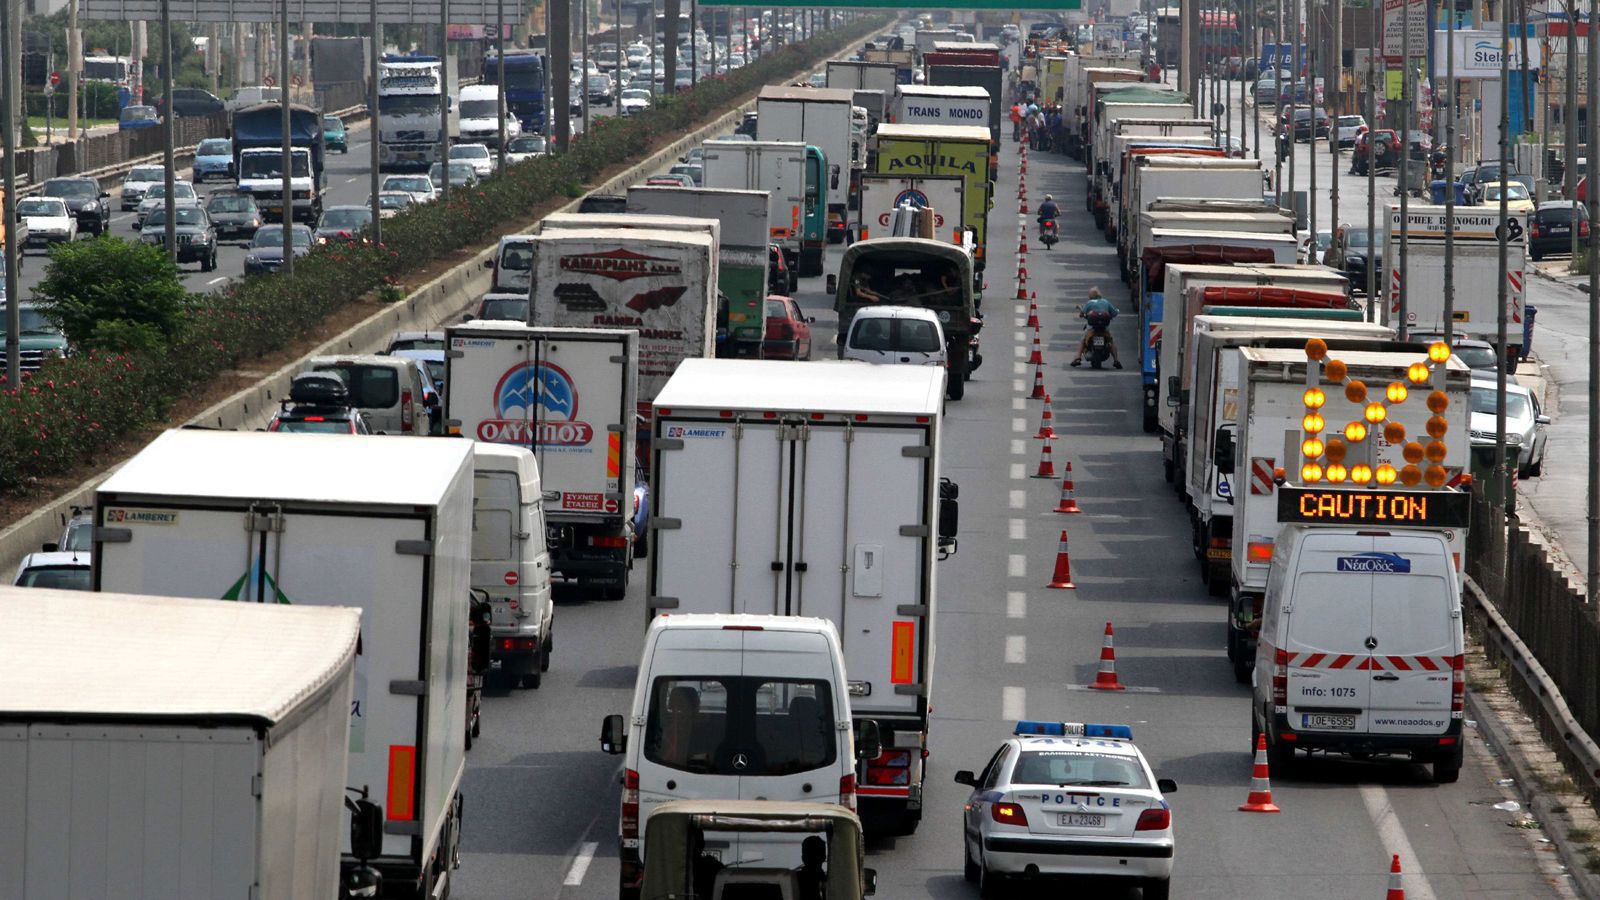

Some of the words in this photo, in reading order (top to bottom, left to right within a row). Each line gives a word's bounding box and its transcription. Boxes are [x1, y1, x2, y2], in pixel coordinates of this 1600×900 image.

[908, 106, 941, 118] TRANS
[949, 108, 983, 119] MONDO
[888, 154, 977, 174] AQUILA
[1393, 215, 1433, 225] OPHEE
[1439, 215, 1495, 226] BINOGLOU
[683, 429, 725, 437] LAMBERET
[566, 501, 599, 509] ΣΤΑΣΕΙΣ
[1300, 493, 1427, 520] CAUTION
[124, 512, 176, 521] LAMBERET
[1343, 558, 1394, 573] ΝέαΟδός
[1302, 686, 1327, 697] info:
[1330, 687, 1356, 697] 1075
[1375, 718, 1446, 728] www.neaodos.gr
[1064, 725, 1084, 735] POLICE
[1041, 794, 1120, 807] POLICE
